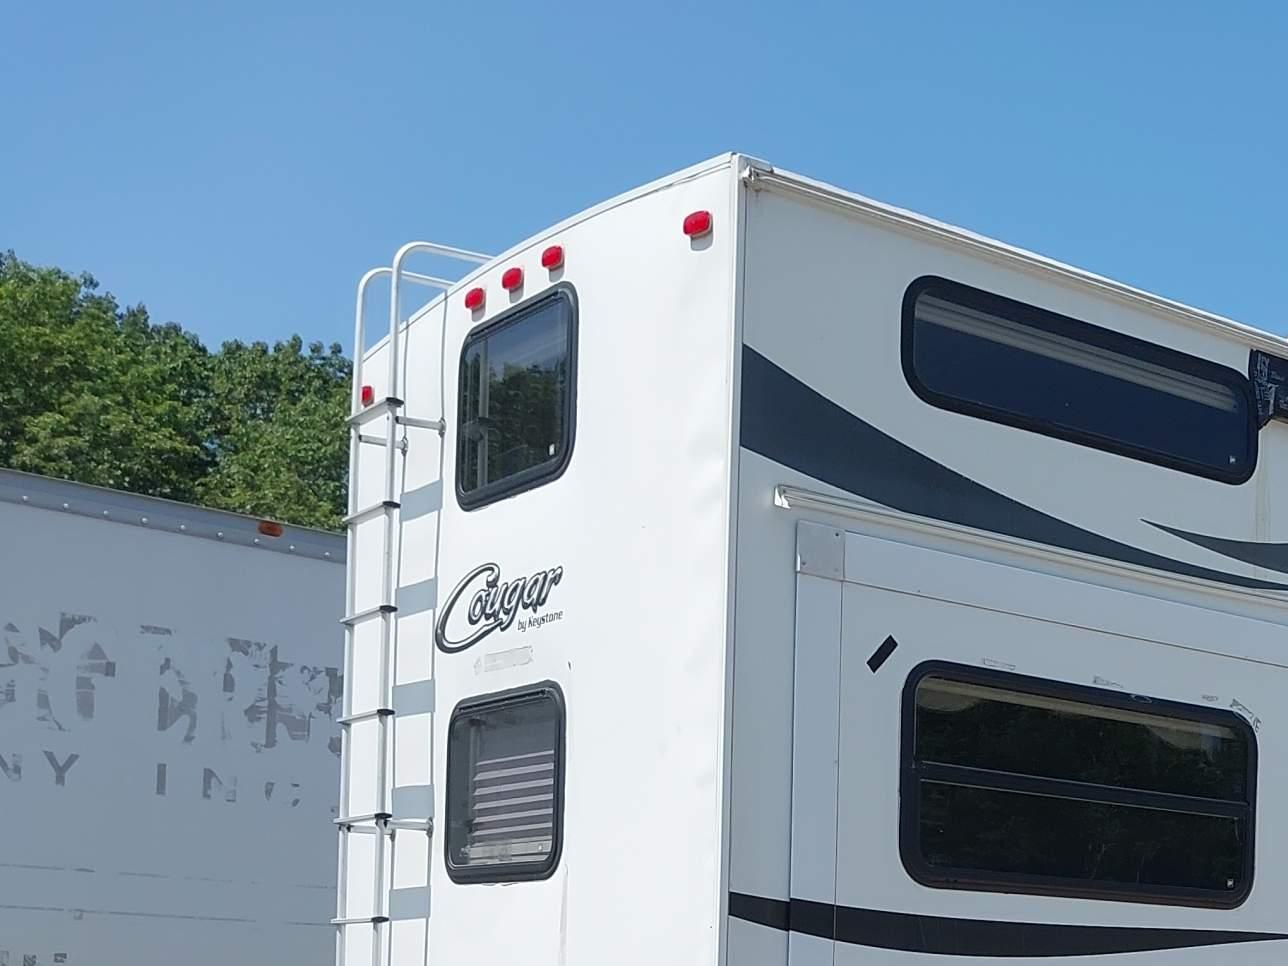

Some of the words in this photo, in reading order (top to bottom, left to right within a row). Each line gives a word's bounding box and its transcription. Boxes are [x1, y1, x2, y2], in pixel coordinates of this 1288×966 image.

[435, 562, 563, 654] Cougar
[517, 618, 527, 632] by
[527, 610, 564, 629] Keystone
